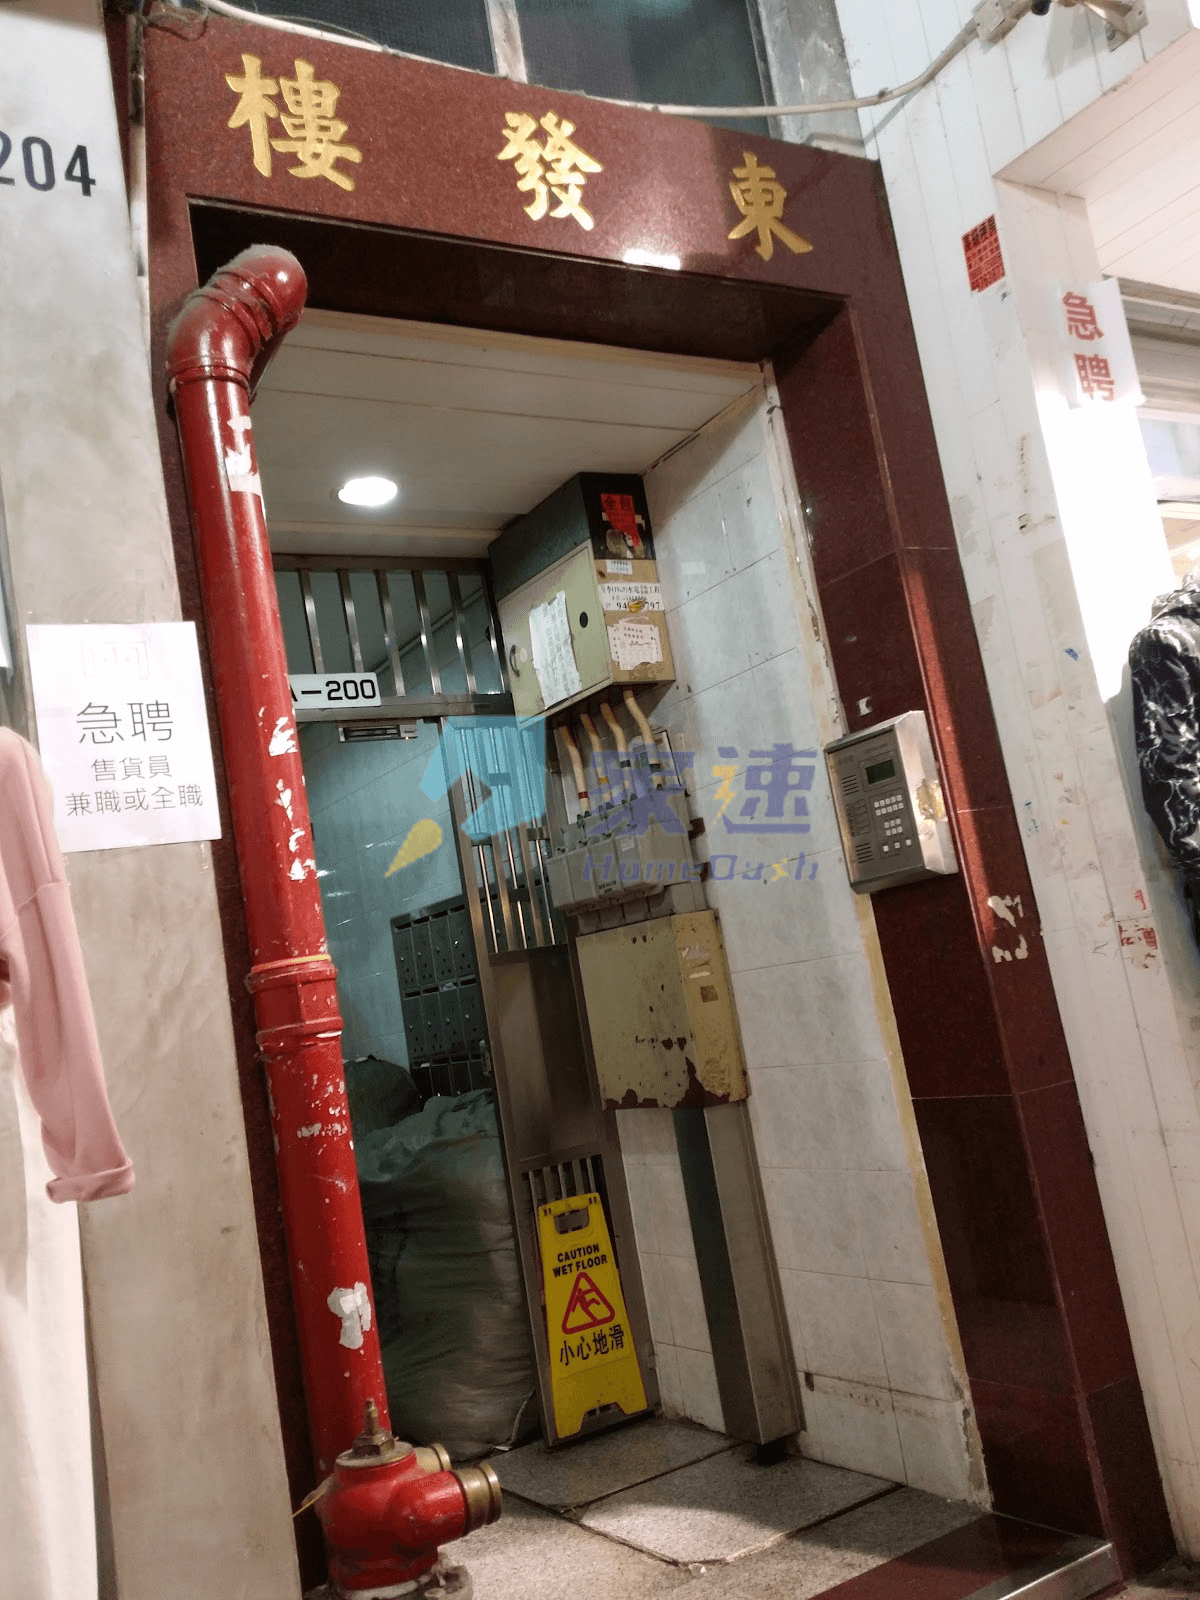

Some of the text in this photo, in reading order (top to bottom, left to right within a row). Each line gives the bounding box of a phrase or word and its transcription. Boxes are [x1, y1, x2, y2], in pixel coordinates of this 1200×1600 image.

[76, 700, 174, 744] 急聘
[91, 755, 173, 783] 售貨員
[65, 784, 204, 817] 兼職或全職
[552, 1254, 608, 1278] WET FLOOR
[557, 1243, 600, 1264] CAUTION
[559, 1324, 625, 1367] 小心地滑
